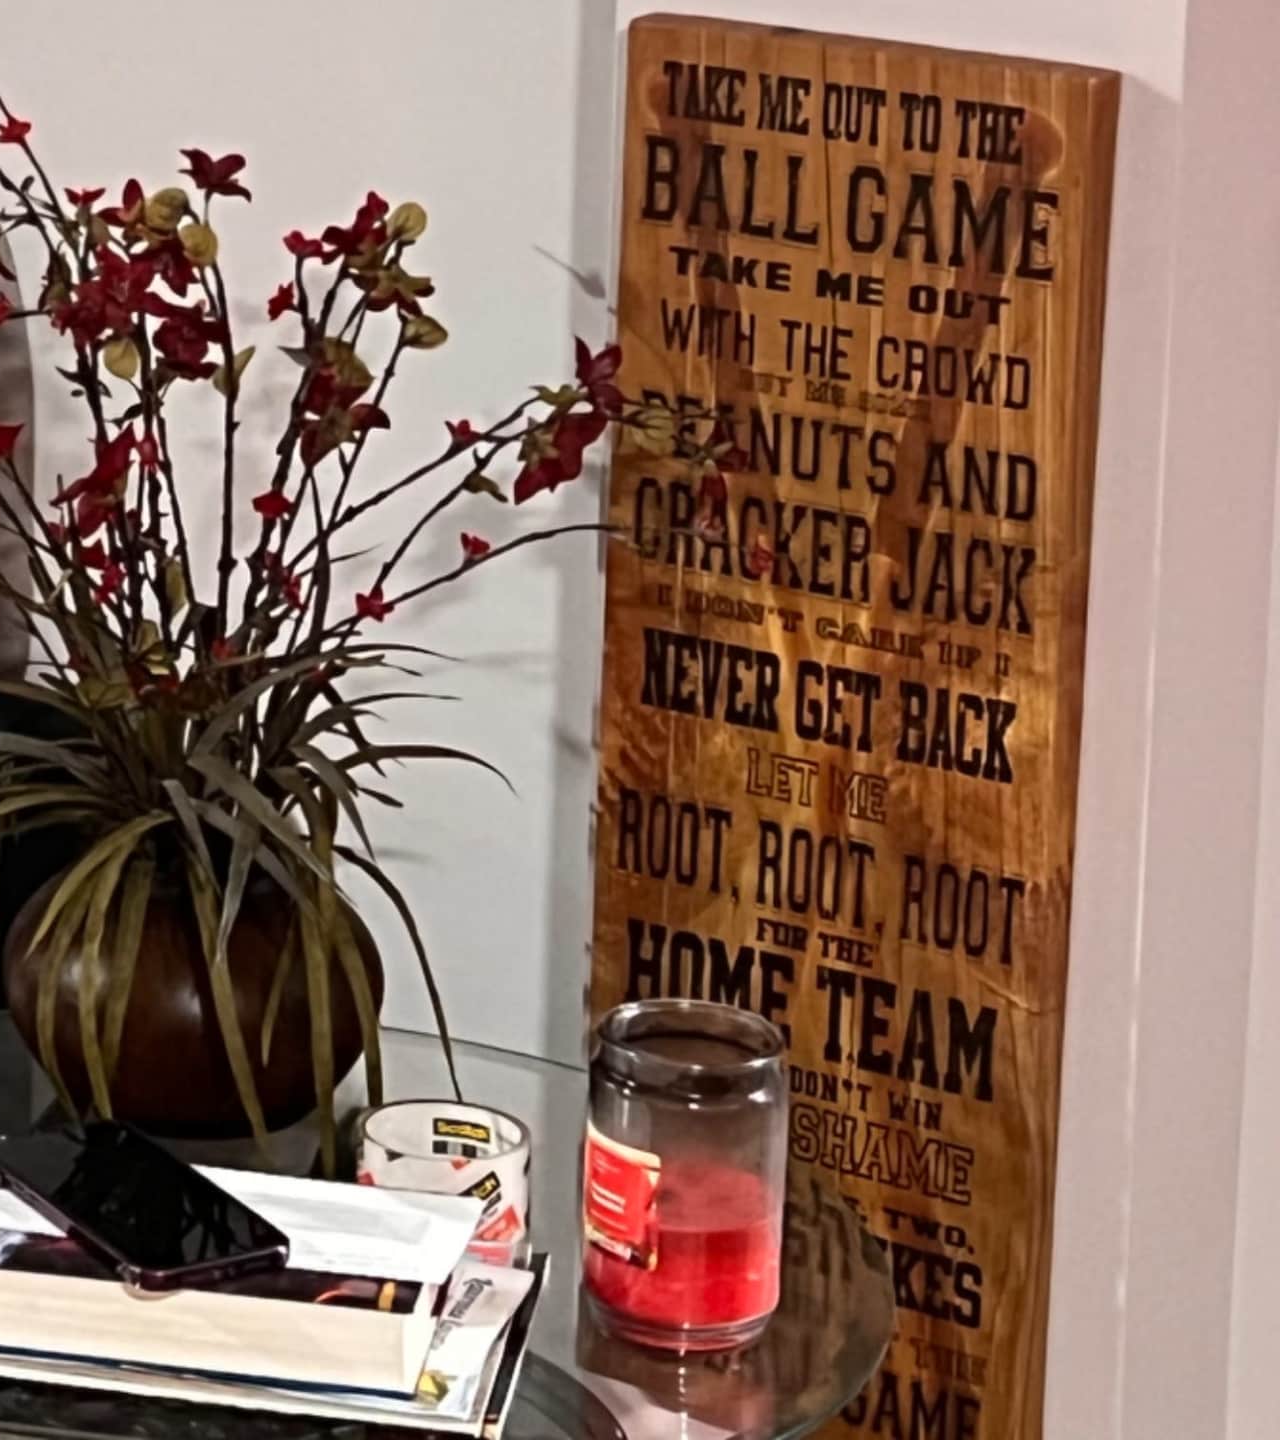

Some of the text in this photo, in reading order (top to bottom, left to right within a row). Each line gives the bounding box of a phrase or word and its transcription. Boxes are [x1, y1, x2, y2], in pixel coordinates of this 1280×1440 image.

[663, 60, 1025, 165] TAKE ME OUT TO THE
[640, 134, 1061, 284] BALL GAME
[669, 245, 1011, 325] TAKE ME OUT
[660, 298, 1032, 411] WITH THE CROWD
[641, 389, 1039, 524] ENUTS AND
[633, 476, 1038, 636] CRACKER JACK
[684, 590, 804, 635] DON'T
[815, 615, 925, 661] CARE
[641, 625, 1019, 786] NEVER GET BACK
[746, 749, 889, 827] LET ME
[617, 788, 740, 905] ROOT,
[899, 854, 1026, 967] ROOT
[755, 916, 875, 969] FOR THE
[624, 917, 1000, 1105] HOME TEAM
[789, 1064, 943, 1132] DON'T WIN
[790, 1102, 976, 1208] SHAME
